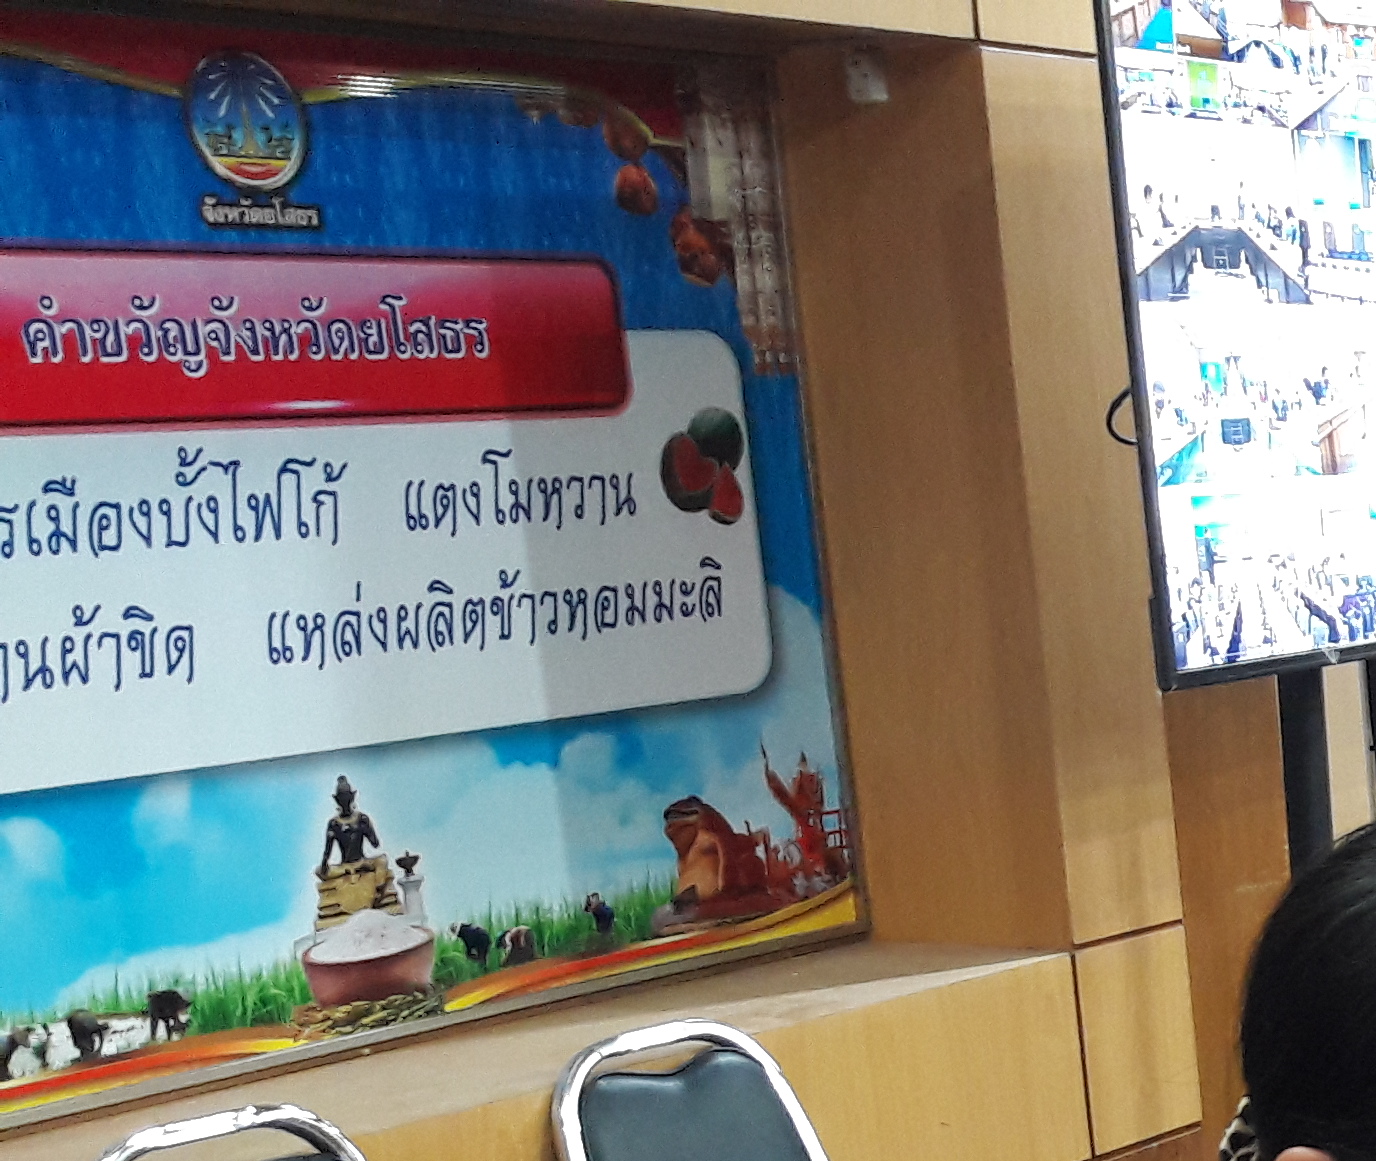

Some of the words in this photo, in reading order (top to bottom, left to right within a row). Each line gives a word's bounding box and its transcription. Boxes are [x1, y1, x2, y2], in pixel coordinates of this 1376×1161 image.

[22, 294, 492, 380] คำขวัญจังหวัดยโสธร
[404, 450, 638, 540] แตงโมหวาน
[266, 557, 724, 671] แหล่งผลิตข้าวหอมมะลิ
